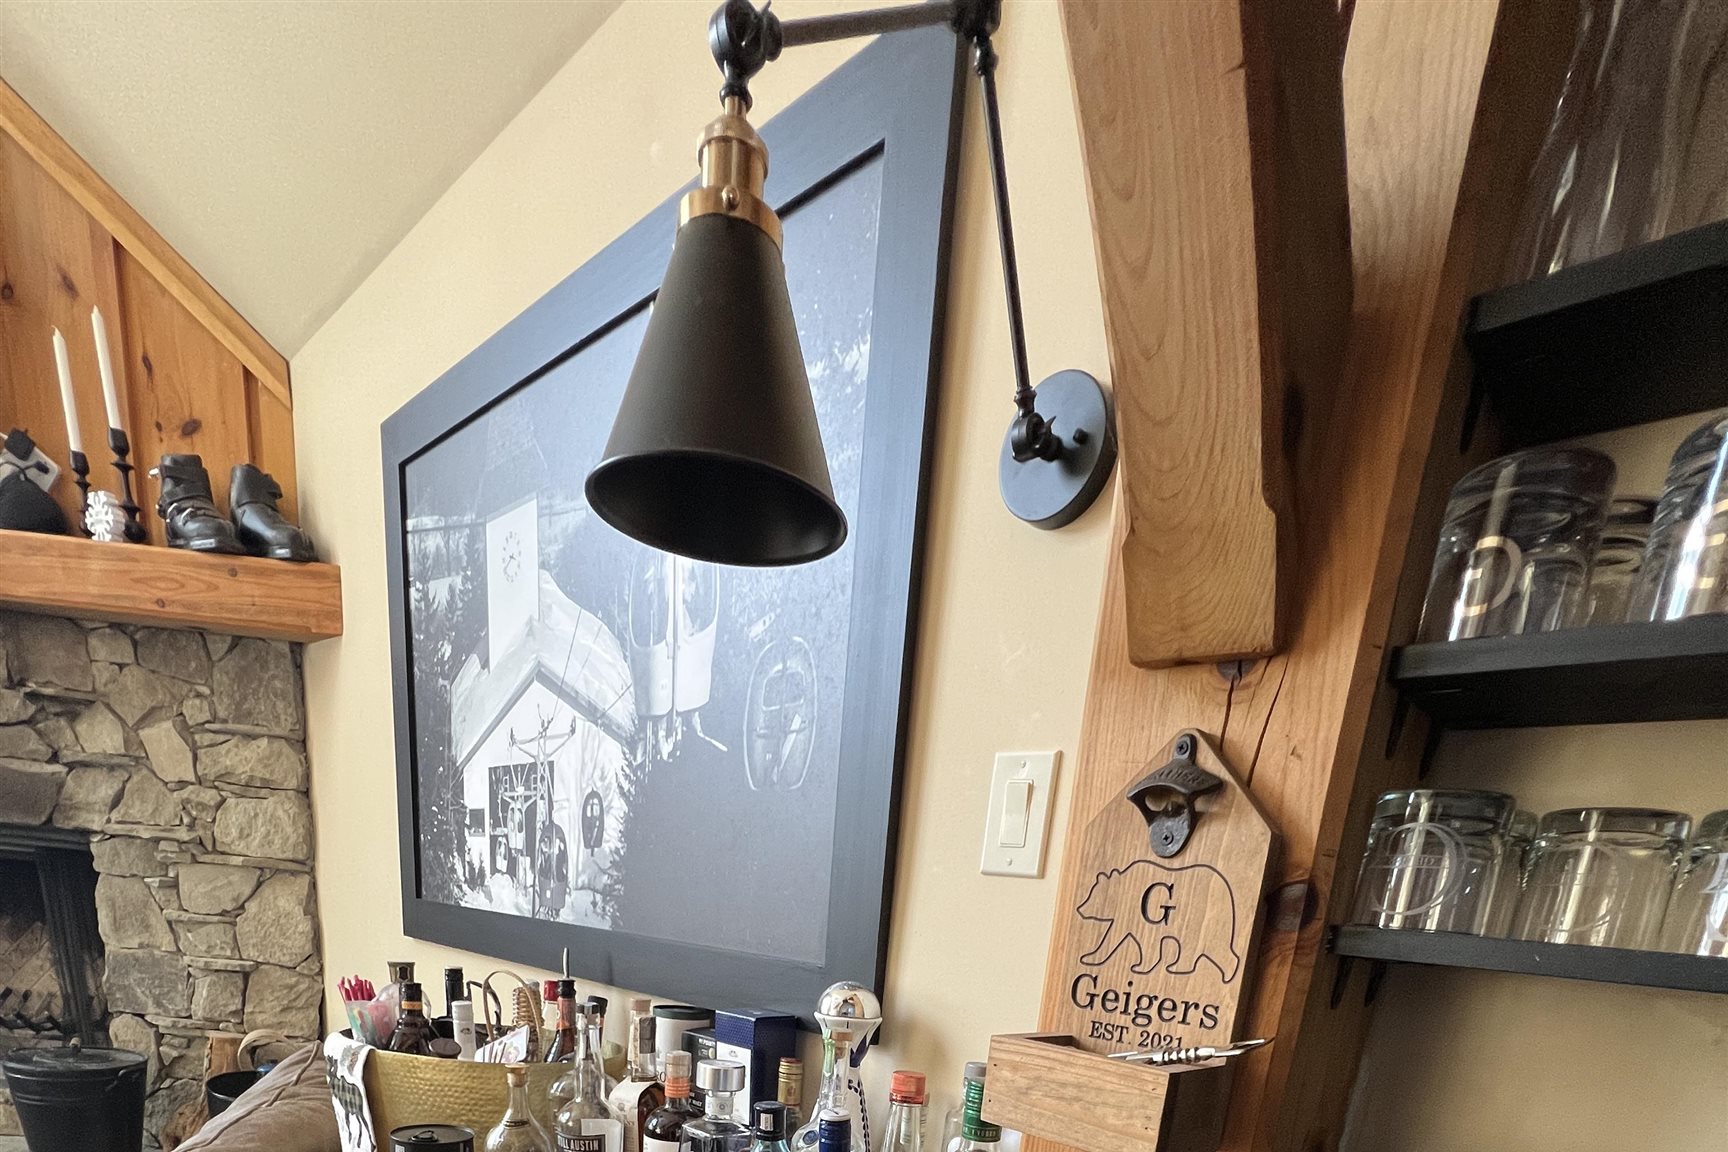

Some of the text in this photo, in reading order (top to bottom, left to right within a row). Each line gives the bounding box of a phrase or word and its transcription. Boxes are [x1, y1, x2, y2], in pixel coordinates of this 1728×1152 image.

[1141, 881, 1177, 926] G
[1070, 973, 1221, 1031] Geigers
[1088, 1020, 1182, 1050] EST. 2021
[570, 1139, 599, 1152] AUSTIN
